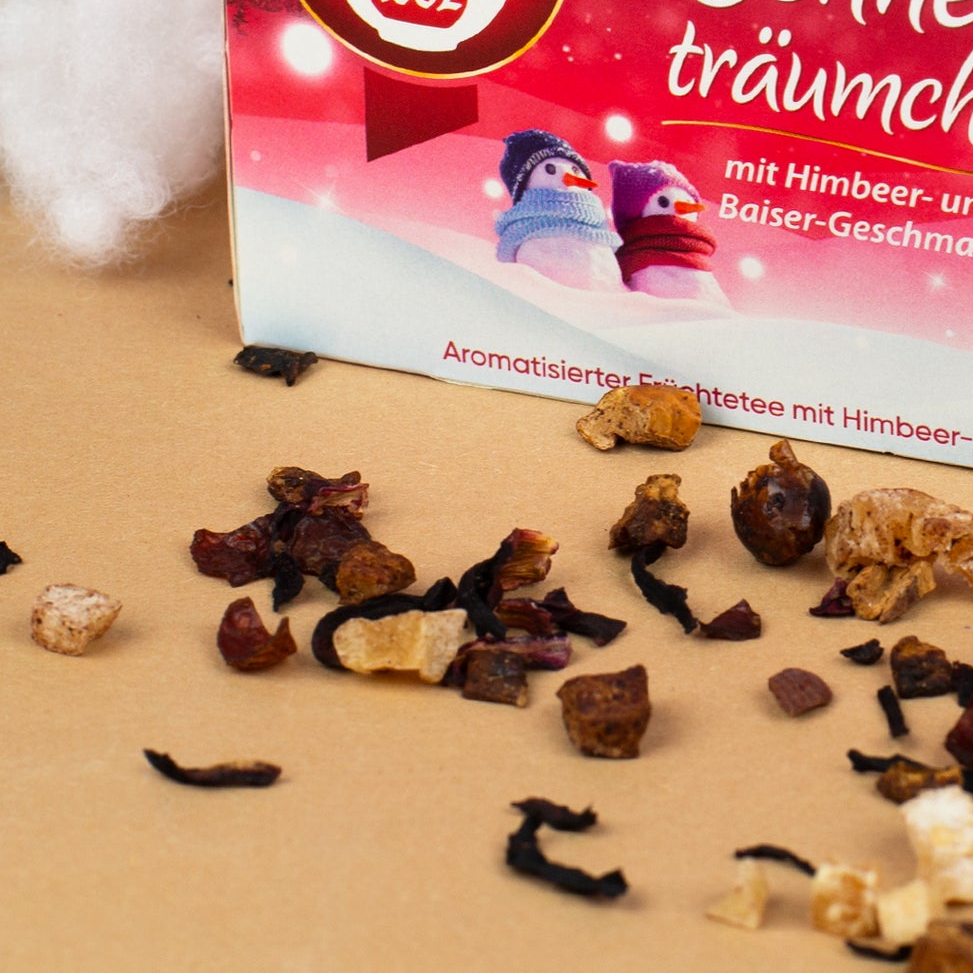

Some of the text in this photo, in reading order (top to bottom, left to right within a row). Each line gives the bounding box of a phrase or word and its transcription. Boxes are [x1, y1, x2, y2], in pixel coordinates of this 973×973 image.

[724, 157, 778, 187] mit
[784, 163, 933, 208] Himbeer-
[442, 340, 631, 390] Aromatisierter
[639, 372, 785, 418] Fhtetee
[792, 403, 835, 427] mit
